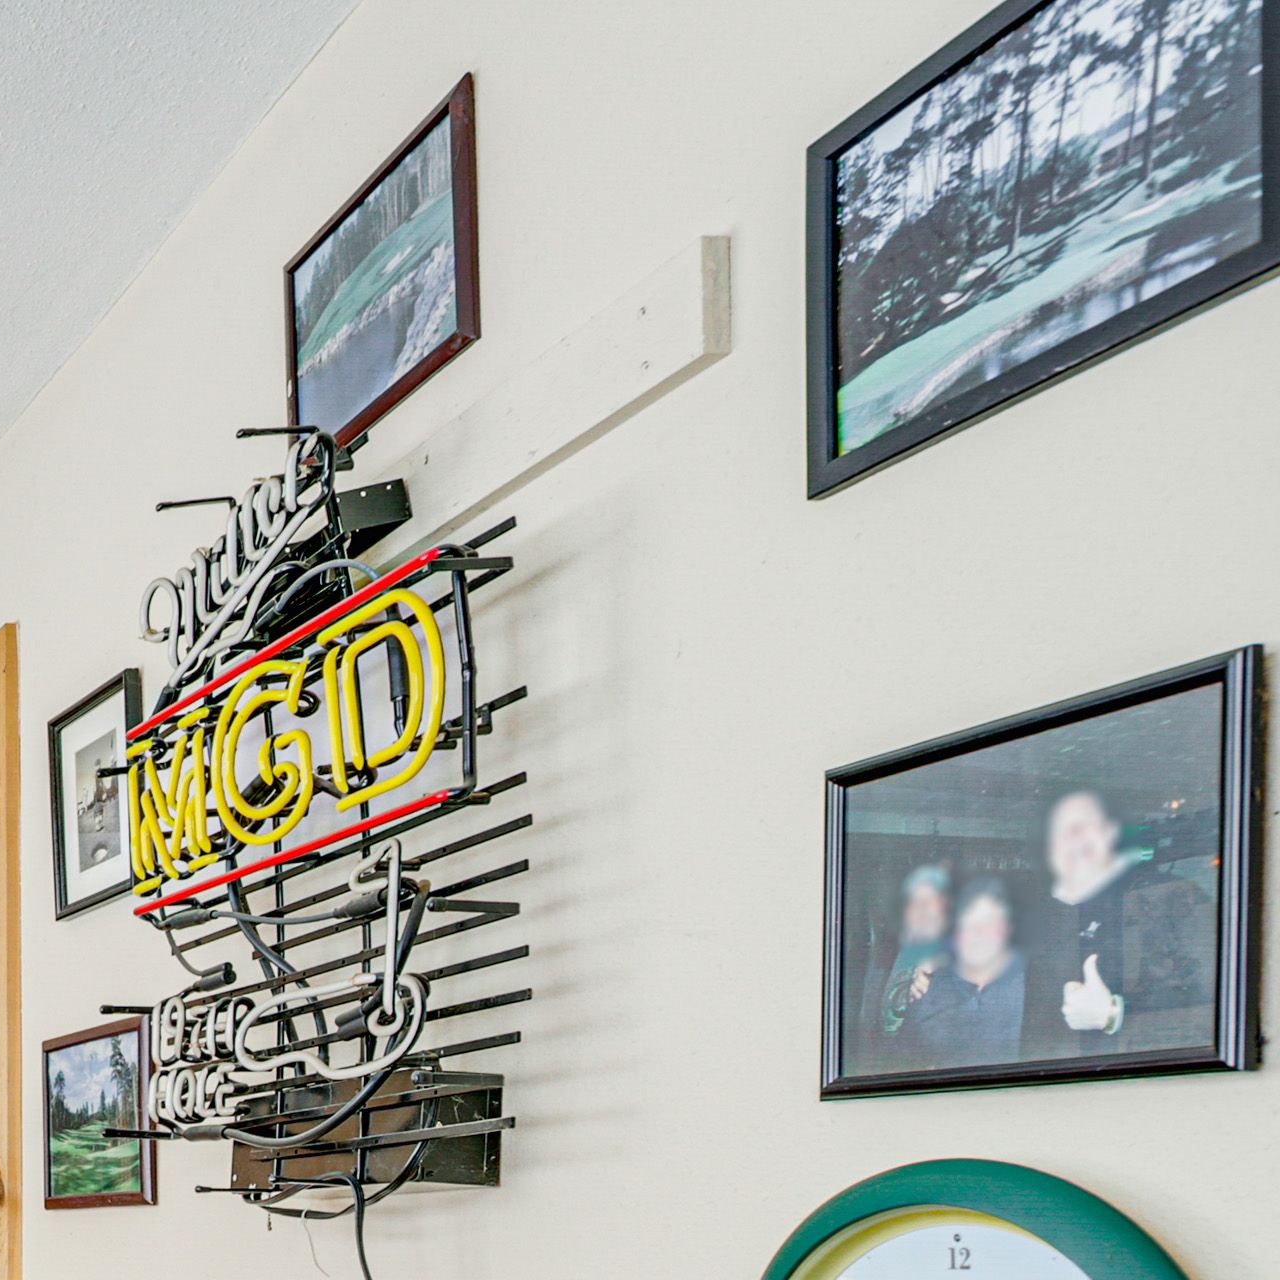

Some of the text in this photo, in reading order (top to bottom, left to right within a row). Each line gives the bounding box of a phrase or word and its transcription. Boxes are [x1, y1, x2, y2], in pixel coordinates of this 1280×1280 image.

[128, 589, 444, 897] MGD
[149, 1063, 237, 1124] HOLE
[947, 1246, 972, 1271] 12
